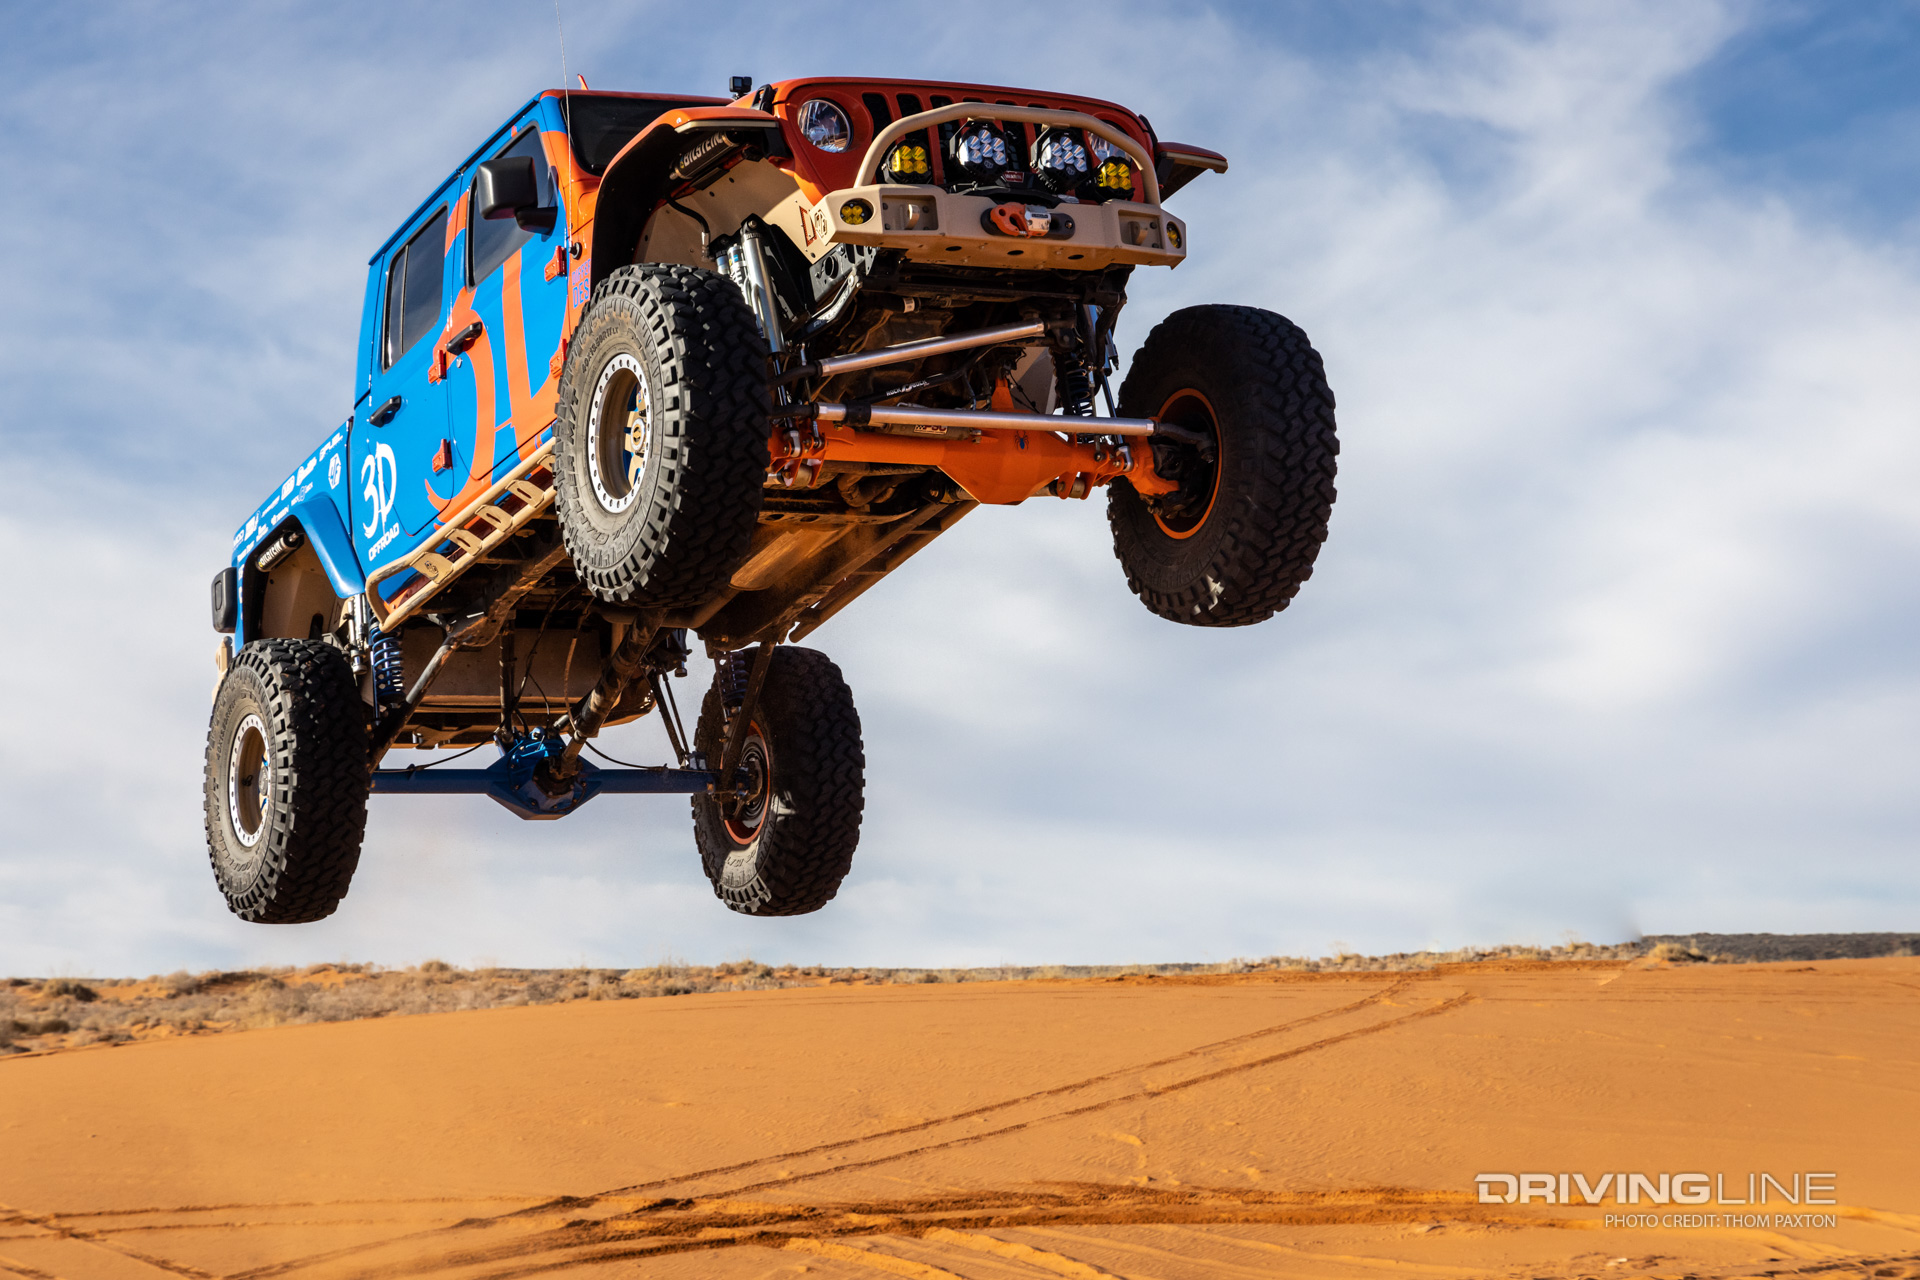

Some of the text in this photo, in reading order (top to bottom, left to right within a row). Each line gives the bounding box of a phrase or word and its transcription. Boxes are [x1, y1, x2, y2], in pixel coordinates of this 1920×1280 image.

[683, 132, 723, 167] BILSTEIN
[361, 441, 396, 539] 3D
[368, 522, 400, 561] OFFROAD
